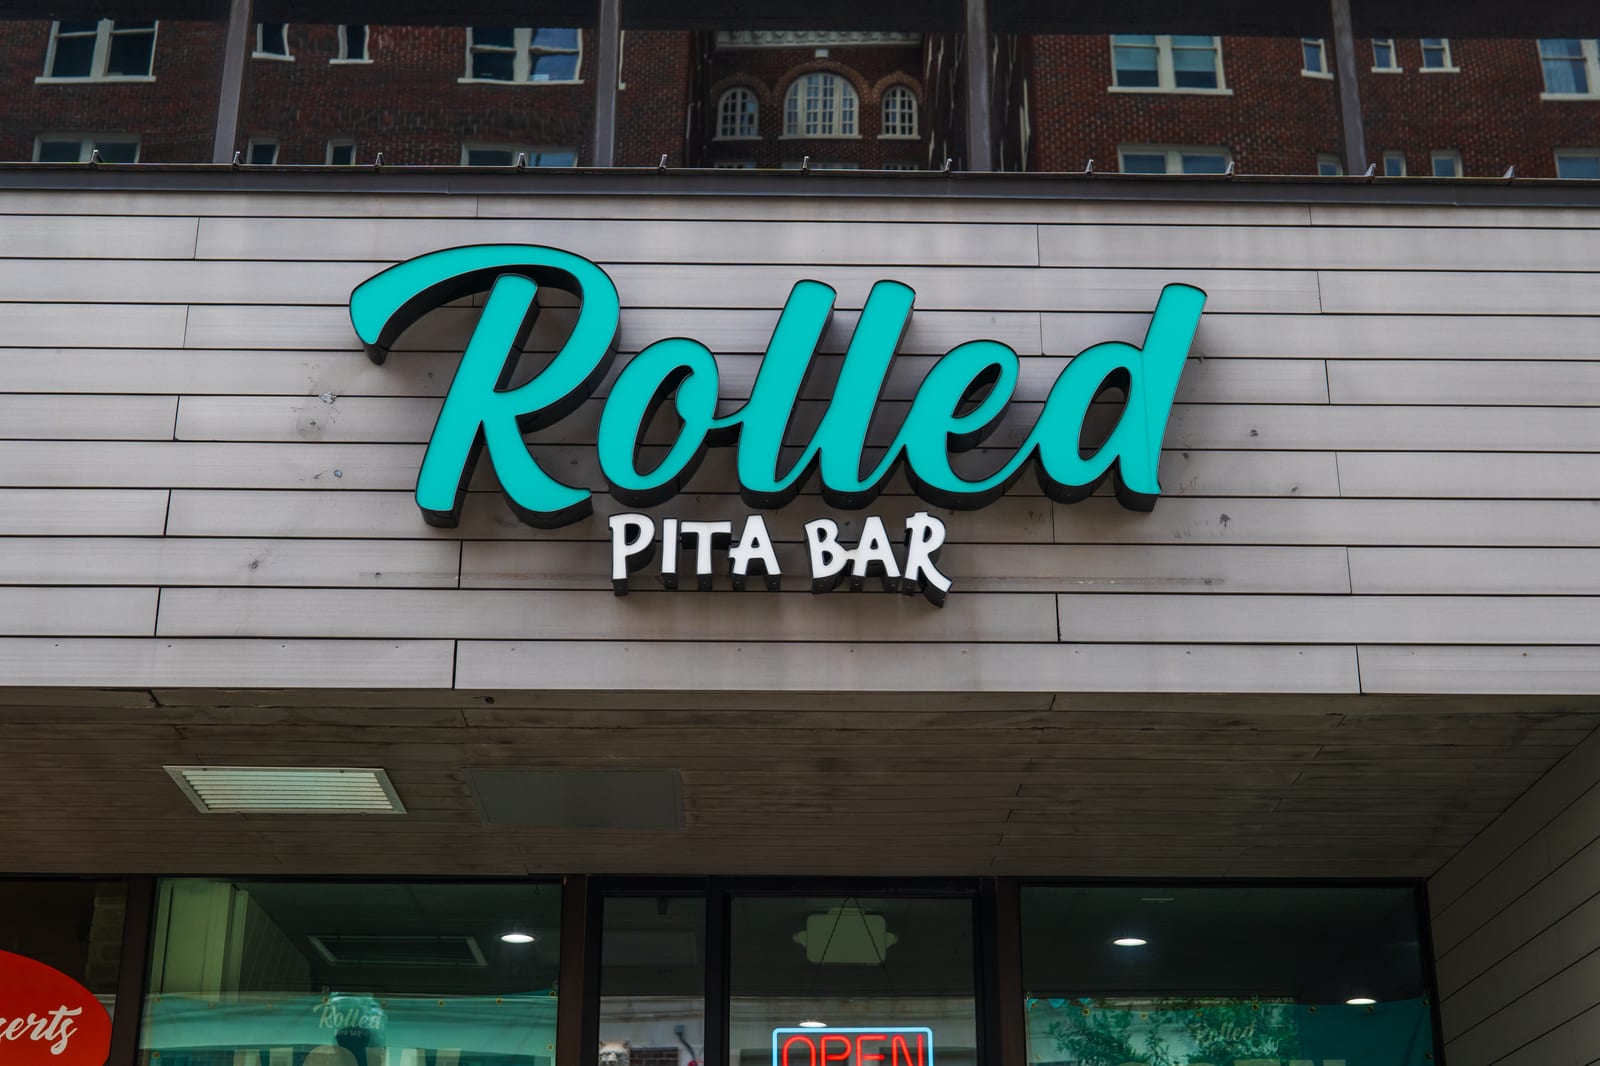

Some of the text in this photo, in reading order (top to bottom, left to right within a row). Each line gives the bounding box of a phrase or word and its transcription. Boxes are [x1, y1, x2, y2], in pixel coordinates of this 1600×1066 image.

[350, 244, 1207, 513] Rolled
[609, 511, 952, 593] PITA BAR
[782, 1034, 924, 1066] OPEN
